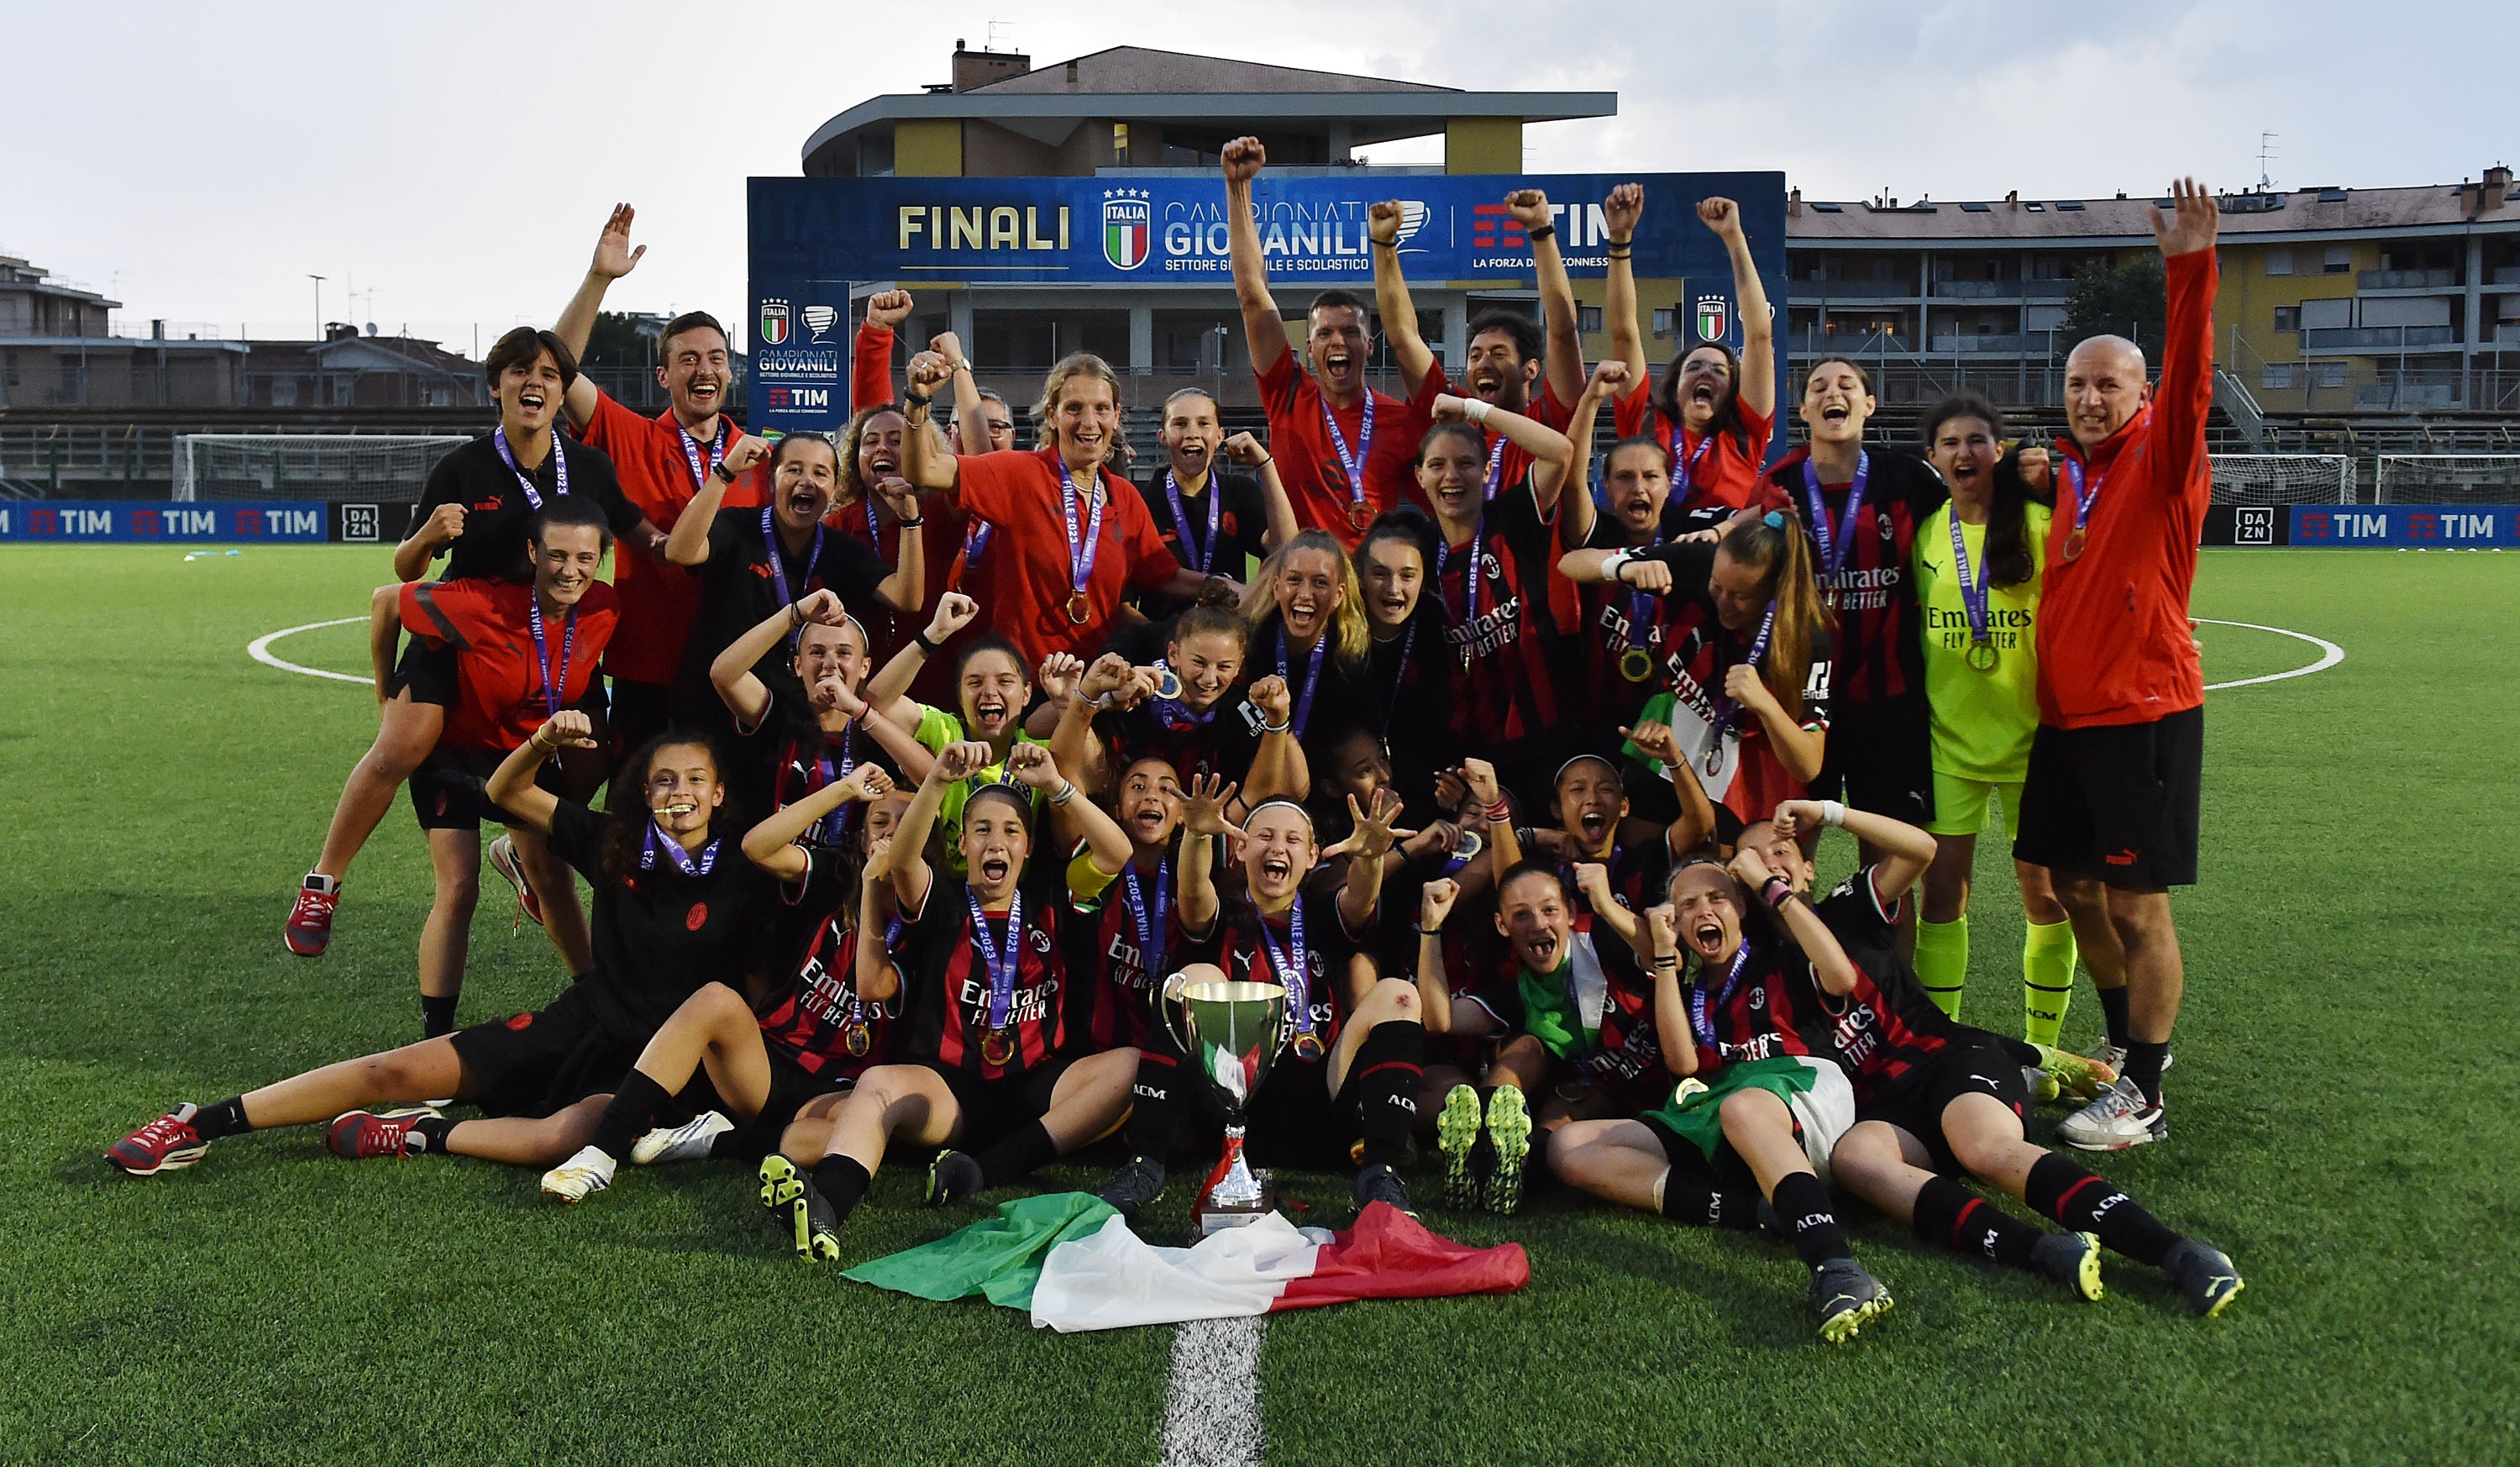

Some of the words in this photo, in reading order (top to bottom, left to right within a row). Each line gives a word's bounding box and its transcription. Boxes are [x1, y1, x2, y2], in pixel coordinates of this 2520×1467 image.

[1106, 206, 1146, 219] ITALIA
[900, 206, 1068, 250] FINALI
[1165, 259, 1216, 271] SETTORE
[1220, 259, 1284, 271] GIILE
[1286, 259, 1294, 271] E
[1296, 258, 1368, 271] SCOLASTICO
[1473, 258, 1487, 267] LA
[1489, 258, 1524, 267] FORZA
[764, 308, 786, 316] ITALIA
[1699, 304, 1722, 313] ITALIA
[759, 349, 837, 359] CAMPIONATI
[759, 358, 837, 371] GIOVANILI
[791, 389, 828, 407] TIM
[1360, 417, 1373, 441] 2023
[1334, 439, 1354, 469] FINALE
[556, 466, 567, 494] 2023
[1062, 480, 1074, 513] FINALE
[60, 509, 112, 534] TIM
[163, 509, 215, 534] TIM
[266, 509, 318, 534] TIM
[350, 509, 371, 522] DA
[1090, 502, 1100, 528] 2023
[2244, 513, 2265, 525] DA
[2334, 514, 2386, 538] TIM
[2441, 514, 2494, 538] TIM
[350, 523, 370, 535] ZN
[1066, 518, 1078, 544] 2023
[1950, 522, 1963, 549] 2023
[2244, 526, 2265, 539] ZN
[1814, 564, 1900, 591] mirates
[1956, 551, 1971, 587] FINALE
[1841, 590, 1887, 611] BETTER
[531, 605, 543, 640] FINALE
[1928, 607, 2031, 628] Emates
[564, 626, 575, 653] 2023
[1476, 622, 1518, 659] BETTER
[1754, 612, 1773, 649] FINALE
[1942, 632, 1965, 649] FLY
[1746, 650, 1761, 664] 20
[1126, 873, 1141, 902] 2023
[1009, 888, 1022, 923] FINALE
[968, 894, 985, 928] FINALE
[979, 931, 995, 960] 2023
[1134, 904, 1149, 942] FINALE
[1290, 905, 1303, 939] FINALE
[1005, 925, 1020, 953] 2023
[1291, 941, 1305, 970] 2023
[799, 989, 827, 1013] FLY
[959, 973, 1059, 1010] Emrates
[970, 1008, 988, 1027] FL
[1834, 1002, 1875, 1049] ates
[1133, 1083, 1167, 1101] ACM
[2091, 1192, 2130, 1222] ACM
[1796, 1212, 1835, 1233] ACM
[1982, 1228, 1998, 1258] CM
